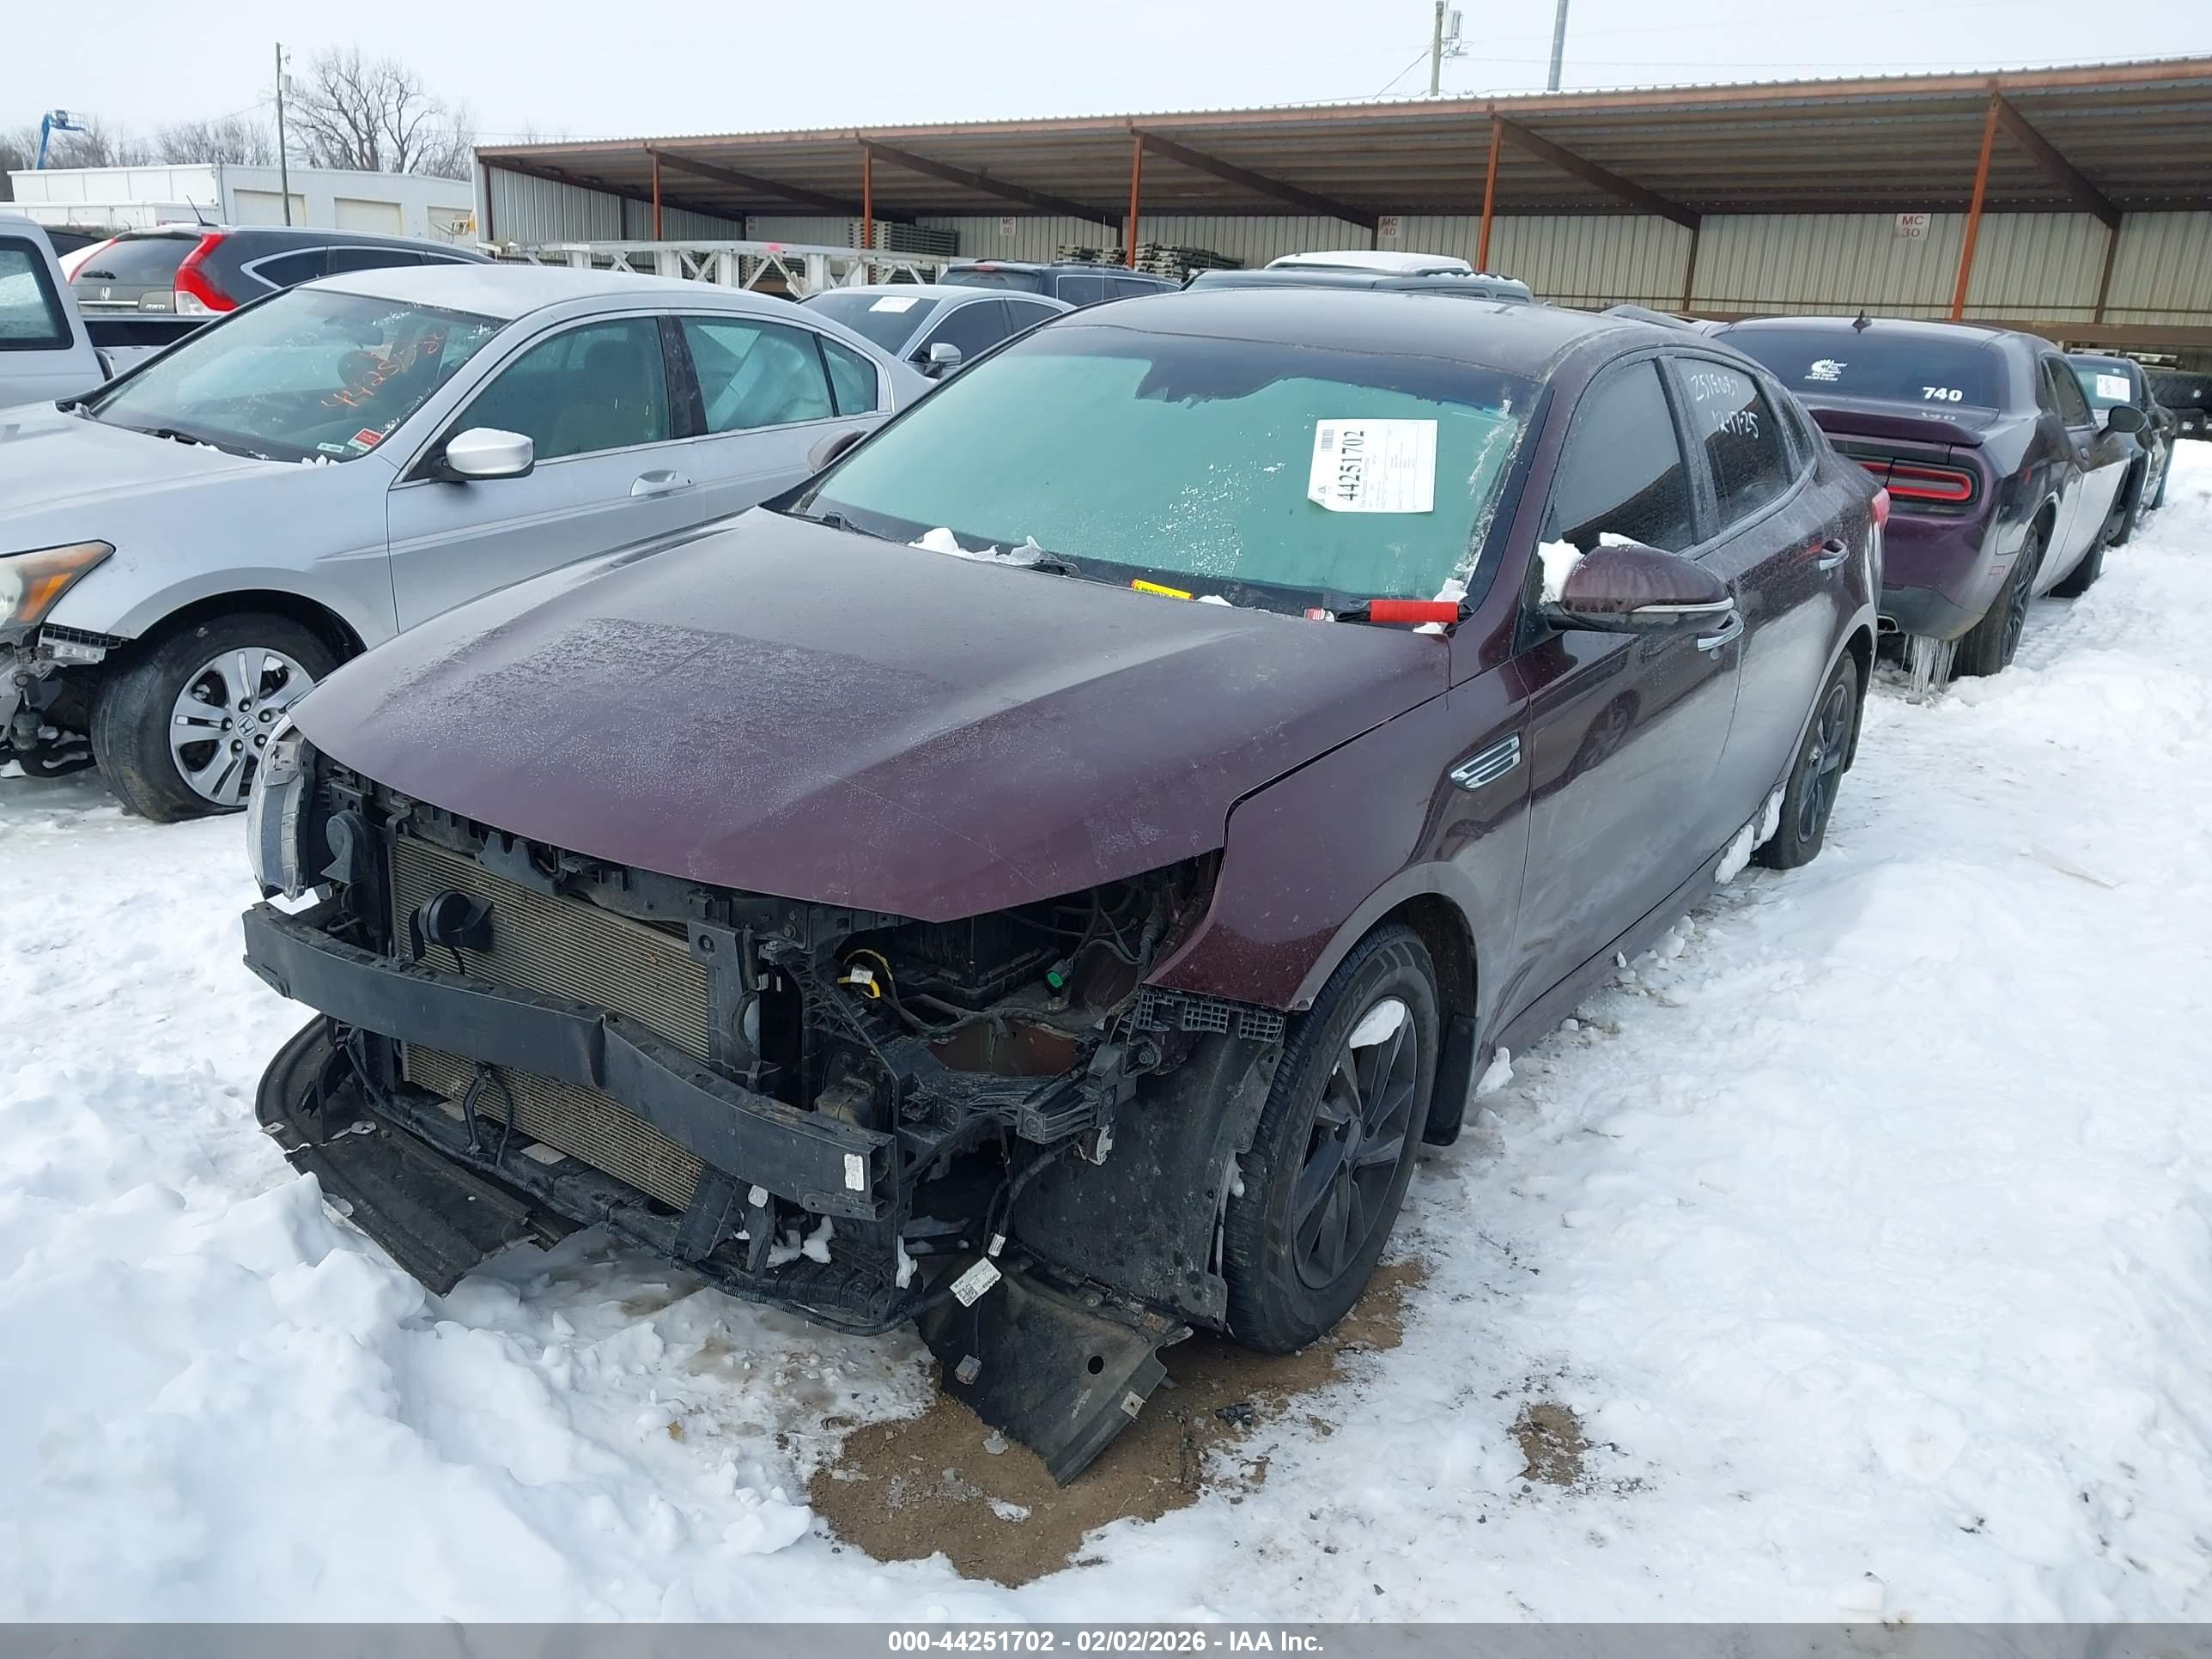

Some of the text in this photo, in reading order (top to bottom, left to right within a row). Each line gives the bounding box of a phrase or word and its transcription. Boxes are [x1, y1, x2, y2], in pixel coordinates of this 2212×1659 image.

[1382, 217, 1398, 226] MC
[1902, 215, 1924, 225] MC
[1902, 227, 1920, 238] 30
[1923, 386, 1963, 401] 740
[1337, 430, 1364, 501] 44251702
